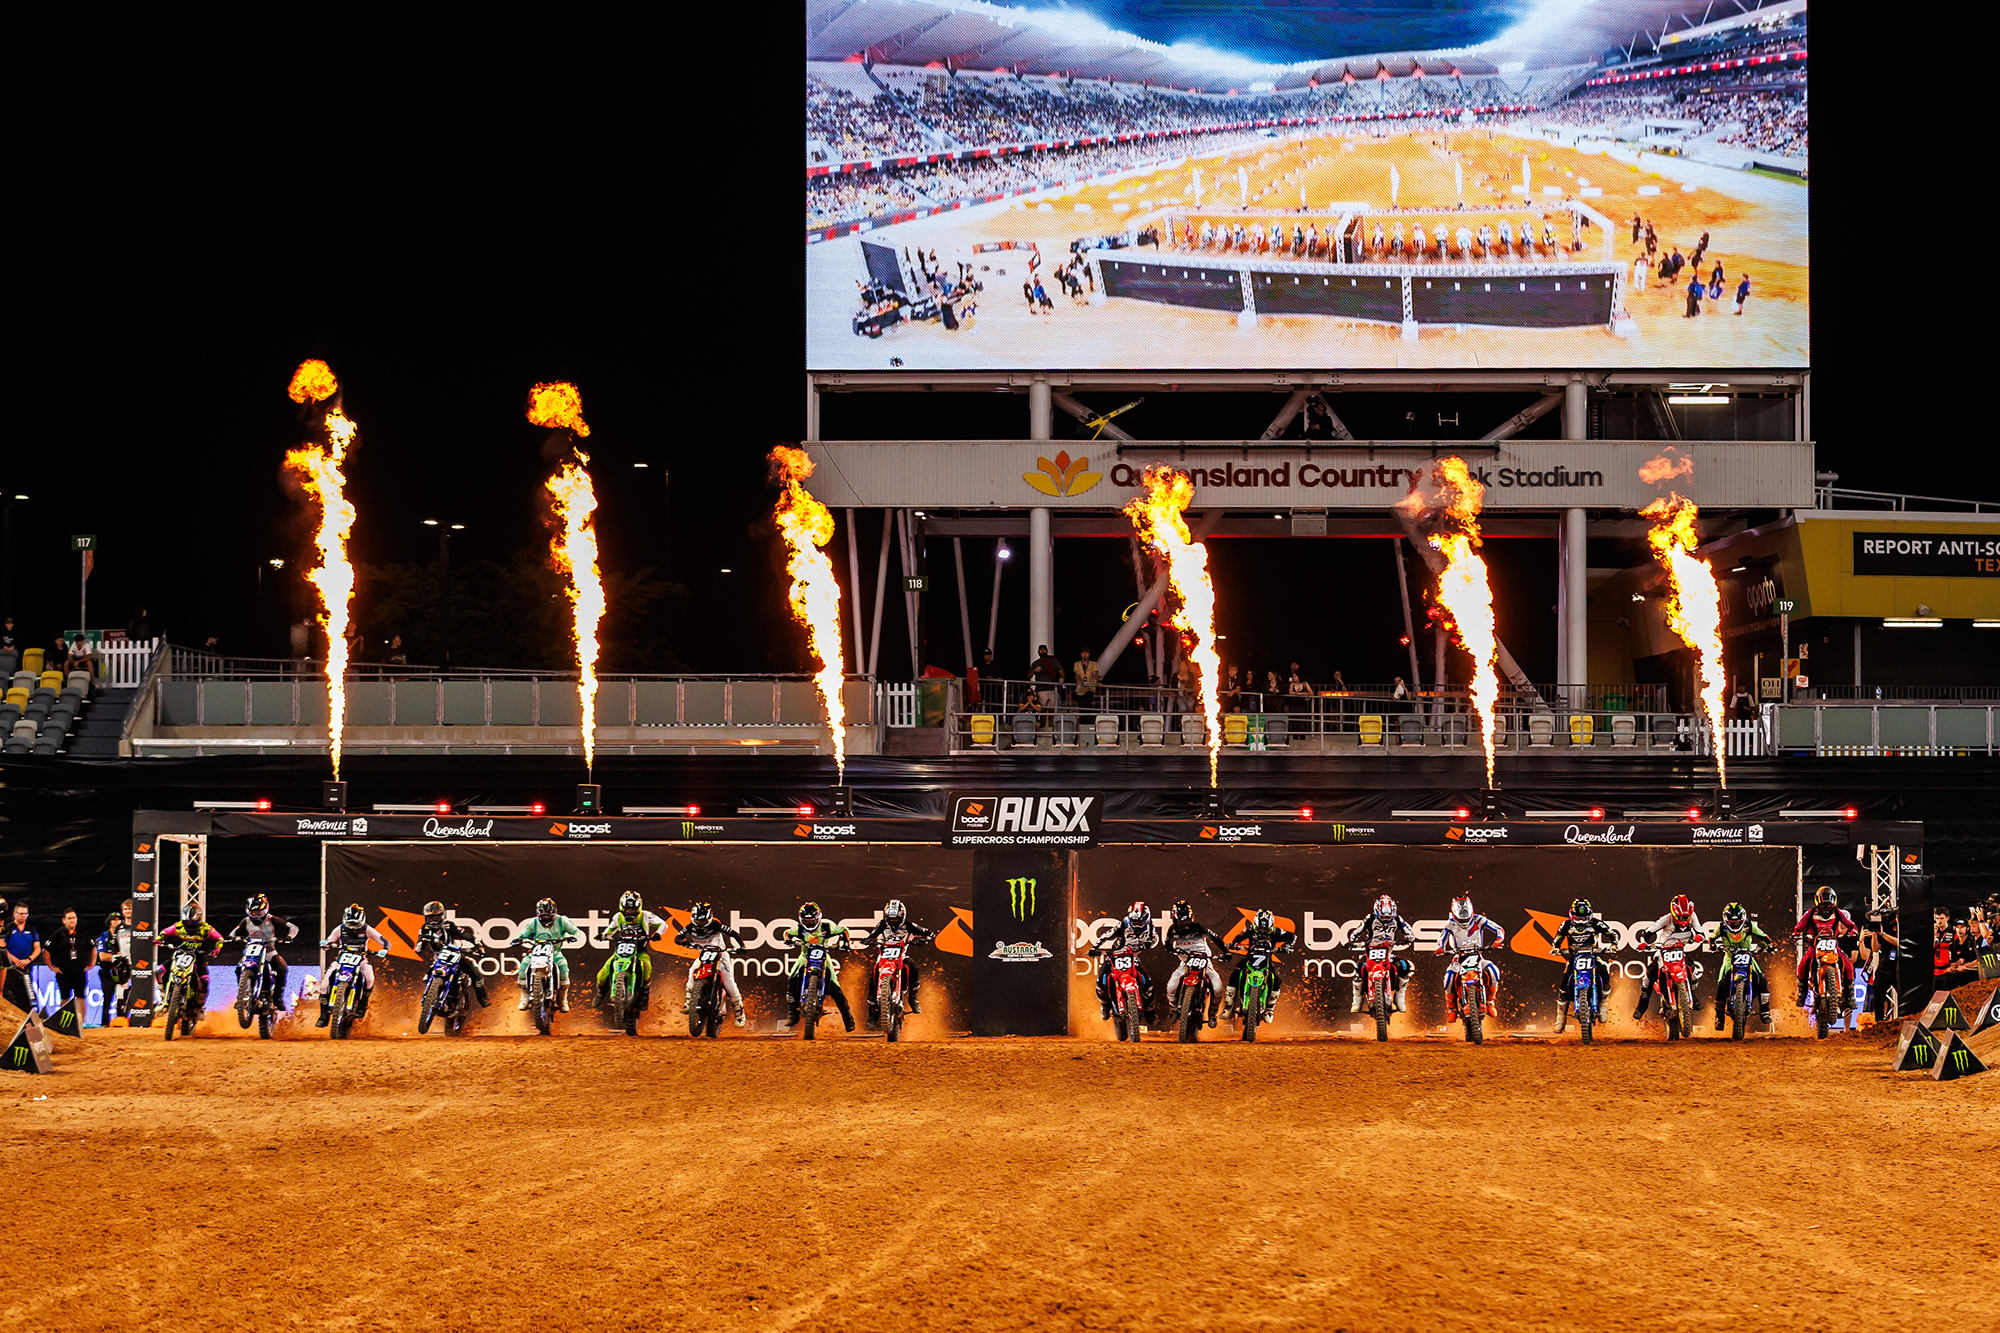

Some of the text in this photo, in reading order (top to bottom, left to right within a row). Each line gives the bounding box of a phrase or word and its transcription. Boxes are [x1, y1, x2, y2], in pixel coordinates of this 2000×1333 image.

[1298, 464, 1424, 494] Country
[1499, 465, 1603, 488] Stadium
[77, 537, 91, 548] 117
[1863, 539, 1932, 555] REPORT
[908, 579, 923, 589] 118
[1779, 601, 1794, 611] 119
[961, 815, 989, 824] boost
[996, 796, 1095, 833] AUSX
[296, 819, 348, 831] TOWNSVILLE
[422, 817, 494, 838] Queensland
[568, 822, 611, 834] boost
[813, 823, 856, 836] boost
[1219, 825, 1262, 837] boost
[1465, 827, 1508, 838] boost
[1563, 824, 1635, 844] Queensland
[1691, 827, 1744, 839] TOWNSVILLE
[952, 836, 1090, 845] SUPERCROSS CHAMPIONSHIP
[248, 944, 264, 956] 8
[532, 944, 551, 957] 44
[616, 943, 636, 955] 86
[1816, 939, 1836, 951] 49
[338, 952, 362, 965] 60
[437, 949, 461, 964] 27
[700, 951, 718, 961] 81
[809, 949, 823, 960] 9
[882, 947, 901, 959] 20
[1368, 948, 1387, 960] 88
[1663, 951, 1683, 963] 800
[1734, 953, 1750, 965] 29
[176, 954, 194, 968] 19
[1114, 956, 1132, 970] 63
[1186, 958, 1207, 968] 460
[1252, 954, 1267, 967] 7
[1460, 954, 1479, 967] 4
[1575, 957, 1593, 970] 61
